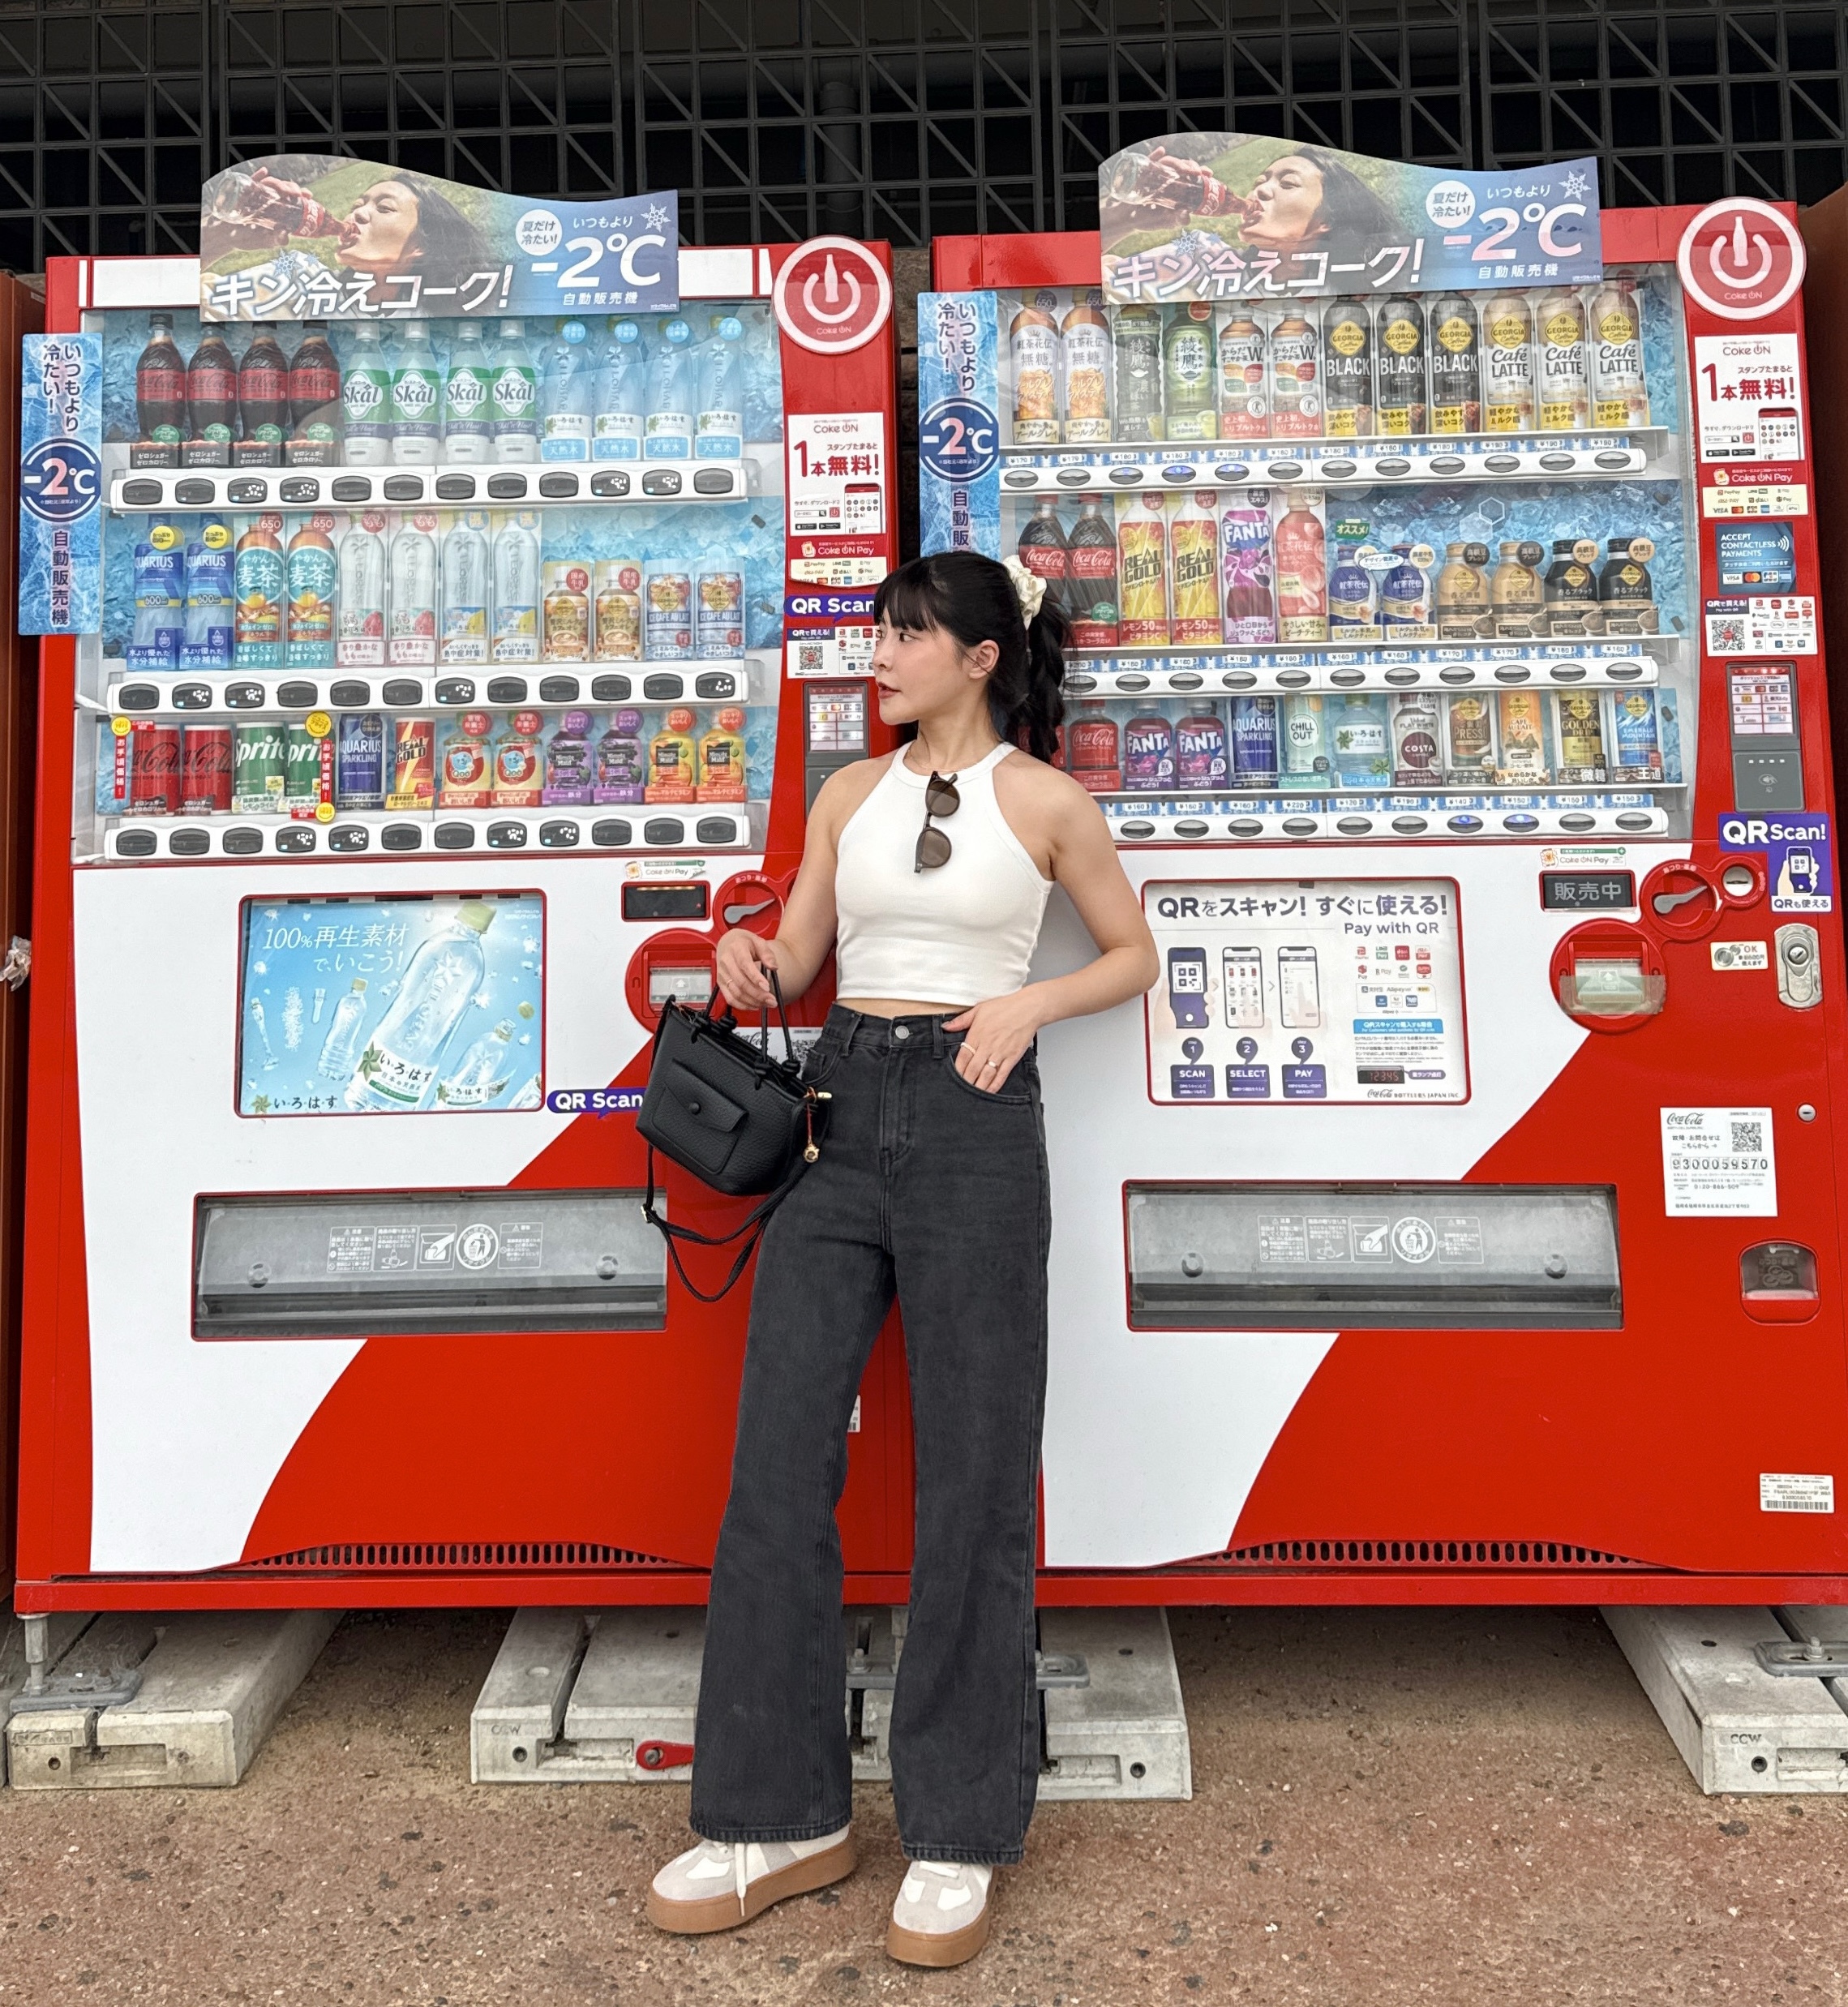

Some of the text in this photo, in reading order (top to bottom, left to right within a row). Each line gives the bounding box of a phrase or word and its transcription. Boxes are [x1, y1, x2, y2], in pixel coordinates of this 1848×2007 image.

[1433, 192, 1468, 203] 夏だけ
[1487, 185, 1550, 199] いつもより
[522, 221, 555, 232] 夏だけ
[573, 217, 633, 229] いつもより
[1478, 264, 1559, 279] 自動販売機
[563, 291, 638, 306] 自動販売機
[959, 303, 976, 391] いつもより
[1017, 338, 1052, 350] 紅茶花伝
[1069, 337, 1104, 349] 紅茶花伝
[1130, 339, 1147, 368] 綾鷹
[1181, 337, 1196, 370] 綾鷹
[1248, 346, 1263, 361] W
[1300, 345, 1315, 360] W
[1492, 349, 1528, 362] Café
[1546, 346, 1581, 361] Café
[1600, 344, 1636, 358] Café
[1723, 347, 1751, 356] Coke
[1022, 353, 1048, 365] 無糖
[1073, 352, 1100, 365] 無糖
[1434, 354, 1477, 373] BLACK
[1327, 358, 1370, 376] BLACK
[1381, 356, 1425, 375] BLACK
[1492, 363, 1529, 378] LATTE
[1546, 362, 1582, 375] LATTE
[1600, 359, 1637, 374] LATTE
[1738, 366, 1793, 374] スタンプたまると
[64, 345, 81, 432] いつもより
[813, 425, 840, 434] Coke
[1016, 430, 1057, 439] アールグレイ
[1067, 429, 1108, 438] アールグレイ
[549, 446, 578, 455] 天然水
[602, 445, 628, 454] 天然水
[1732, 474, 1756, 482] Coke
[1774, 474, 1792, 482] Pay
[261, 520, 281, 529] 650
[314, 519, 332, 528] 650
[1337, 525, 1369, 534] オススメ!
[1225, 522, 1270, 543] FANTA
[818, 547, 840, 555] Coke
[857, 547, 874, 555] Pay
[1722, 541, 1777, 549] CONTACTLESS
[1026, 549, 1065, 566] Coca-Cola
[1073, 549, 1111, 567] Coca-Cola
[1124, 548, 1161, 569] REAL
[1177, 547, 1214, 568] REAL
[238, 565, 281, 587] 麦茶
[289, 565, 332, 587] 麦茶
[1124, 561, 1161, 584] GOLD
[1177, 560, 1214, 582] GOLD
[52, 531, 70, 625] 自動販売機
[791, 598, 821, 614] QR
[1130, 632, 1160, 641] ビタミンC
[131, 658, 168, 667] 水分補給
[185, 657, 221, 665] 水分補給
[1290, 723, 1314, 731] CHILL
[1562, 719, 1599, 729] GOLDEN
[1072, 729, 1113, 747] Coca-Cola
[1179, 731, 1222, 753] FANTA
[1237, 731, 1272, 741] SPARKLING
[1127, 733, 1170, 753] FANTA
[1404, 744, 1434, 753] COSTA
[342, 754, 377, 763] SPARKLING
[397, 748, 427, 764] GOLD
[452, 770, 470, 778] Qoo
[504, 770, 522, 778] Qoo
[1637, 767, 1662, 780] 王道
[1723, 821, 1825, 845] QR Scan!
[1554, 881, 1621, 901] 販売中
[1774, 898, 1829, 908] QRも使える
[1344, 922, 1439, 937] Pay with QR
[263, 924, 409, 950] 100%再生素材
[1244, 1045, 1250, 1053] 2
[1299, 1045, 1306, 1053] 3
[1229, 1070, 1266, 1078] SELECT
[1370, 1071, 1399, 1081] 12345
[555, 1093, 586, 1110] QR
[1666, 1113, 1704, 1125] Coca-Cola
[1730, 1734, 1762, 1744] CCW
